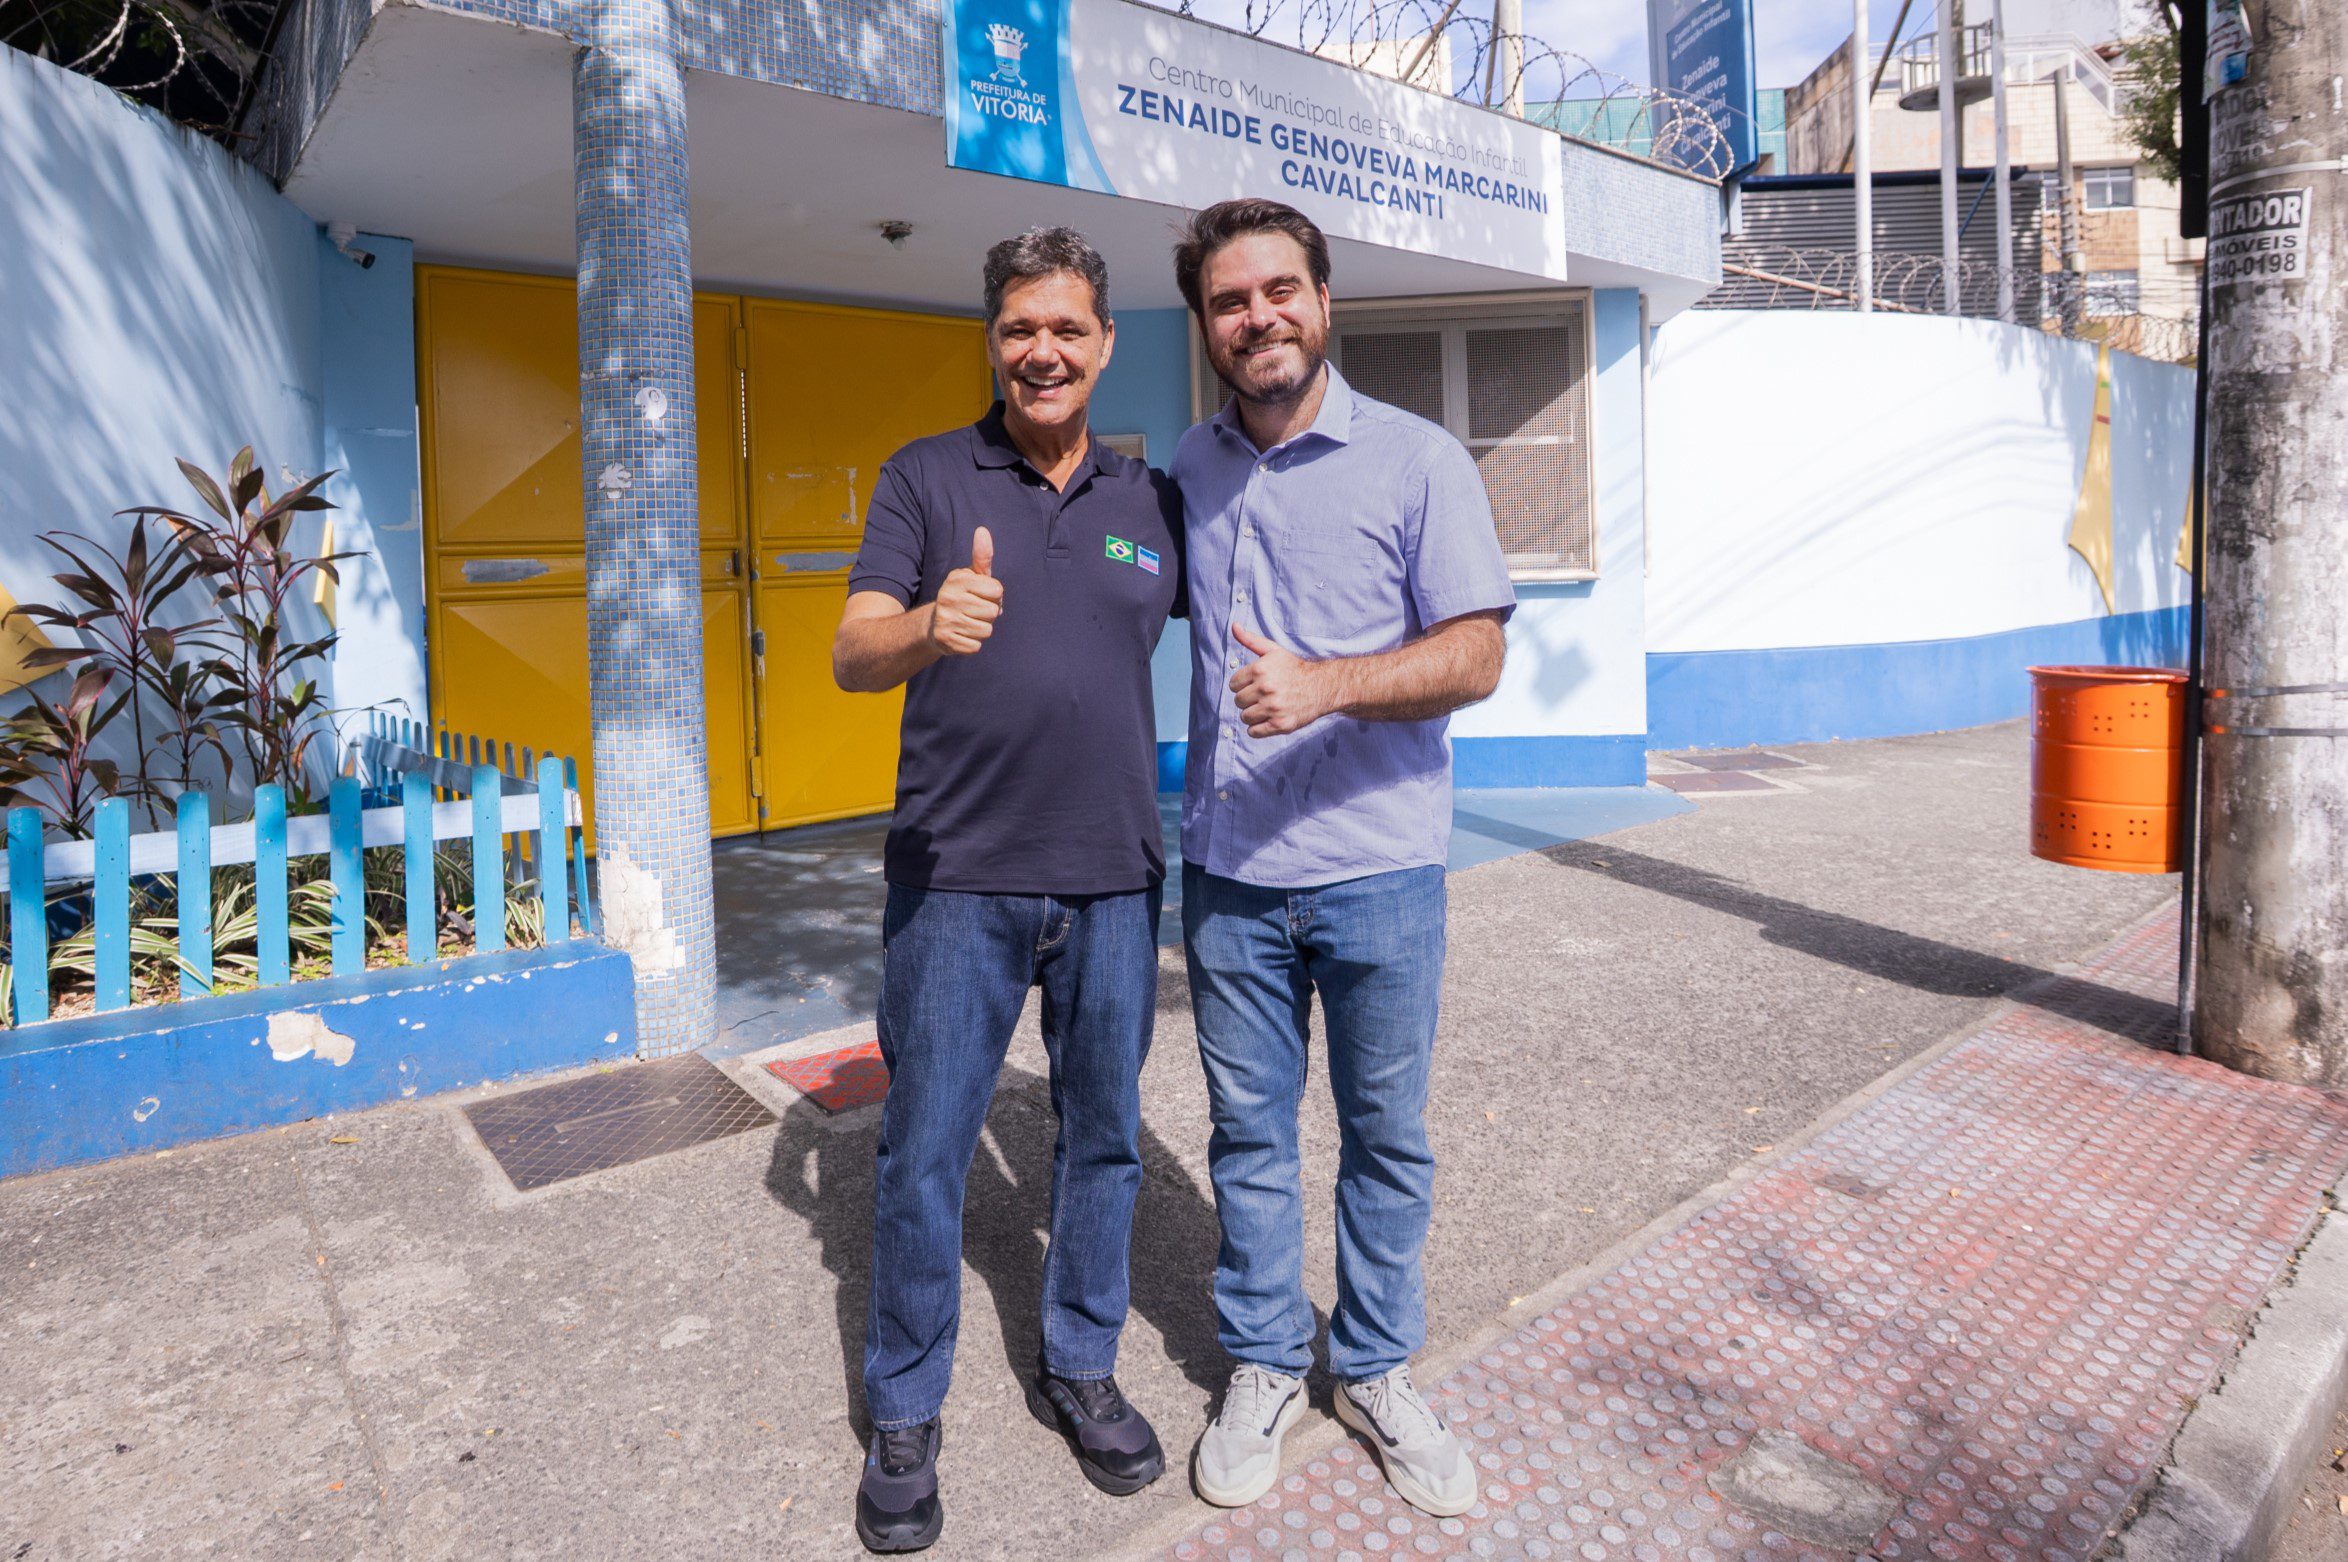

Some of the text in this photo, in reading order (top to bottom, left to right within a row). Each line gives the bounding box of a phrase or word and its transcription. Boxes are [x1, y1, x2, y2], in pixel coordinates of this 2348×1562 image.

[970, 79, 1047, 106] PREFEITURA DE
[1681, 56, 1720, 91] Zenaide
[971, 93, 1048, 126] VITÓRIA
[1149, 56, 1528, 178] Centro Municipal de Educação Infantil
[1117, 83, 1548, 215] ZENAIDE GENOVEVA MARCARINI
[1281, 159, 1443, 220] CAVALCANTI
